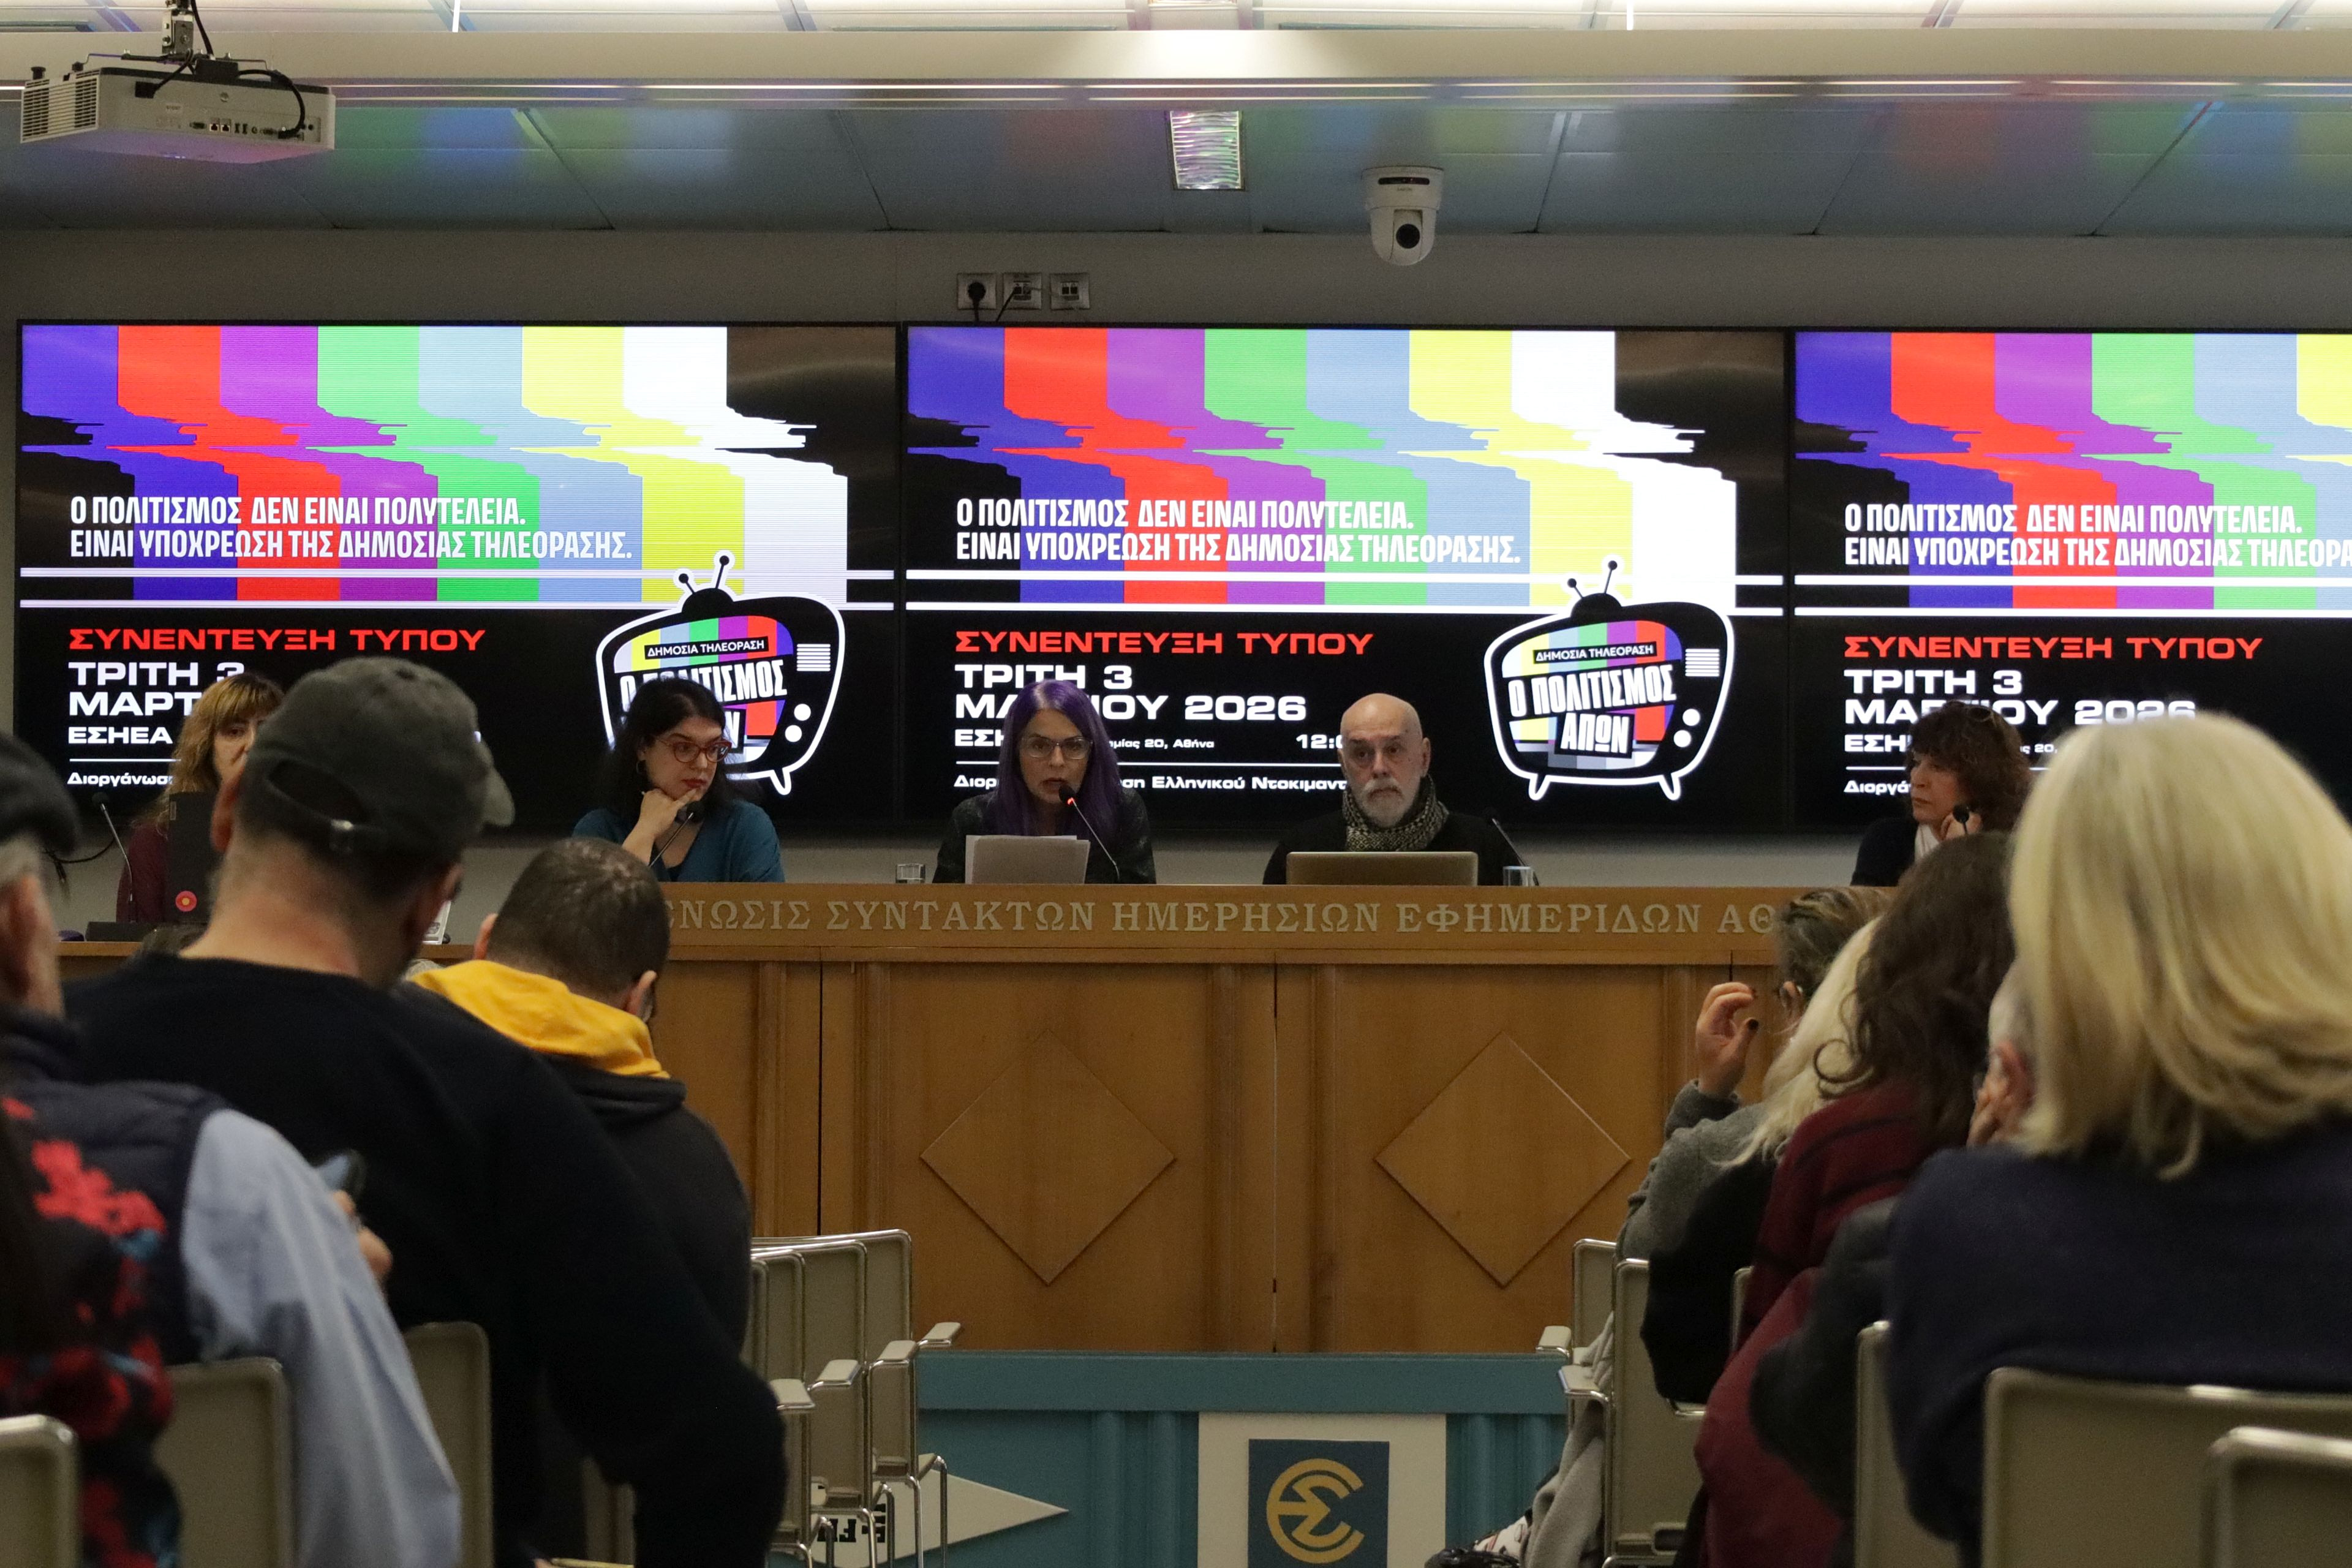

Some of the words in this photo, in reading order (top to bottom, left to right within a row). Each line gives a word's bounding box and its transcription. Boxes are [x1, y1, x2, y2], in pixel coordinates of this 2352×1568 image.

[70, 496, 86, 524] Ο
[92, 497, 242, 524] ΠΟΛΙΤΙΣΜΟΣ
[251, 497, 299, 524] ΔΕΝ
[305, 497, 368, 524] ΕΙΝΑΙ
[374, 497, 526, 525] ΠΟΛΥΤΕΛΕΙΑ.
[957, 499, 973, 526] Ο
[979, 499, 1129, 527] ΠΟΛΙΤΙΣΜΟΣ
[1137, 500, 1186, 527] ΔΕΝ
[1193, 500, 1256, 527] ΕΙΝΑΙ
[1262, 500, 1414, 529] ΠΟΛΥΤΕΛΕΙΑ.
[1845, 504, 1861, 532] Ο
[1867, 504, 2017, 532] ΠΟΛΙΤΙΣΜΟΣ
[2026, 505, 2074, 532] ΔΕΝ
[2081, 505, 2144, 533] ΕΙΝΑΙ
[2150, 505, 2302, 533] ΠΟΛΥΤΕΛΕΙΑ.
[70, 530, 134, 557] ΕΙΝΑΙ
[139, 530, 282, 557] ΥΠΟΧΡΕΩΣΗ
[288, 530, 333, 557] ΤΗΣ
[338, 531, 466, 558] ΔΗΜΟΣΙΑΣ
[470, 531, 632, 559] ΤΗΛΕΟΡΑΣΗΣ.
[957, 532, 1020, 560] ΕΙΝΑΙ
[1026, 533, 1170, 560] ΥΠΟΧΡΕΩΣΗ
[1175, 533, 1221, 561] ΤΗΣ
[1225, 534, 1353, 562] ΔΗΜΟΣΙΑΣ
[1359, 535, 1520, 563] ΤΗΛΕΟΡΑΣΗΣ.
[1845, 538, 1909, 565] ΕΙΝΑΙ
[1915, 538, 2058, 565] ΥΠΟΧΡΕΩΣΗ
[2064, 538, 2109, 566] ΤΗΣ
[2114, 538, 2242, 567] ΔΗΜΟΣΙΑΣ
[2247, 539, 2352, 567] ΤΗΛΕΟΡΑ
[69, 628, 335, 650] ΣΥΝΕΝΤΕΥΞΗ
[350, 629, 486, 651] ΤΥΠΟΥ
[647, 644, 698, 657] ΔΗΜΟΣΙΑ
[700, 640, 765, 654] ΤΗΛΕΟΡΑΣΗ
[956, 631, 1223, 654] ΣΥΝΕΝΤΕΥΞΗ
[1237, 632, 1373, 655] ΤΥΠΟΥ
[1844, 636, 2112, 658] ΣΥΝΕΝΤΕΥΞΗ
[2126, 638, 2263, 659] ΤΥΠΟΥ
[1536, 649, 1587, 662] ΔΗΜΟΣΙΑ
[1589, 645, 1654, 658] ΤΗΛΕΟΡΑΣΗ
[68, 662, 198, 686] ΤΡΙΤΗ
[954, 664, 1085, 689] ΤΡΙΤΗ
[1103, 665, 1133, 690] 3
[1844, 669, 1976, 694] ΤΡΙΤΗ
[1992, 669, 2022, 695] 3
[1508, 679, 1527, 717] Ο
[1531, 665, 1676, 715] ΠΟΛΙΤΙΣΜΟΣ
[69, 692, 202, 716] ΜΑΡΤ
[1185, 696, 1306, 720] 2026
[68, 726, 173, 744] ΕΣΗΕΑ
[1144, 739, 1168, 750] 20,
[1173, 739, 1215, 748] Αθήνα
[1560, 712, 1629, 754] ΑΠΩΝ
[1152, 777, 1245, 790] Ελληνικού
[1251, 777, 1348, 792] Ντοκιμαντ
[826, 901, 1095, 931] ΣΥΝΤΑΚΤΩΝ
[1112, 902, 1381, 932] ΗΜΕΡΗΣΙΩΝ
[1395, 903, 1702, 933] ΕΦΗΜΕΡΙΔΩΝ
